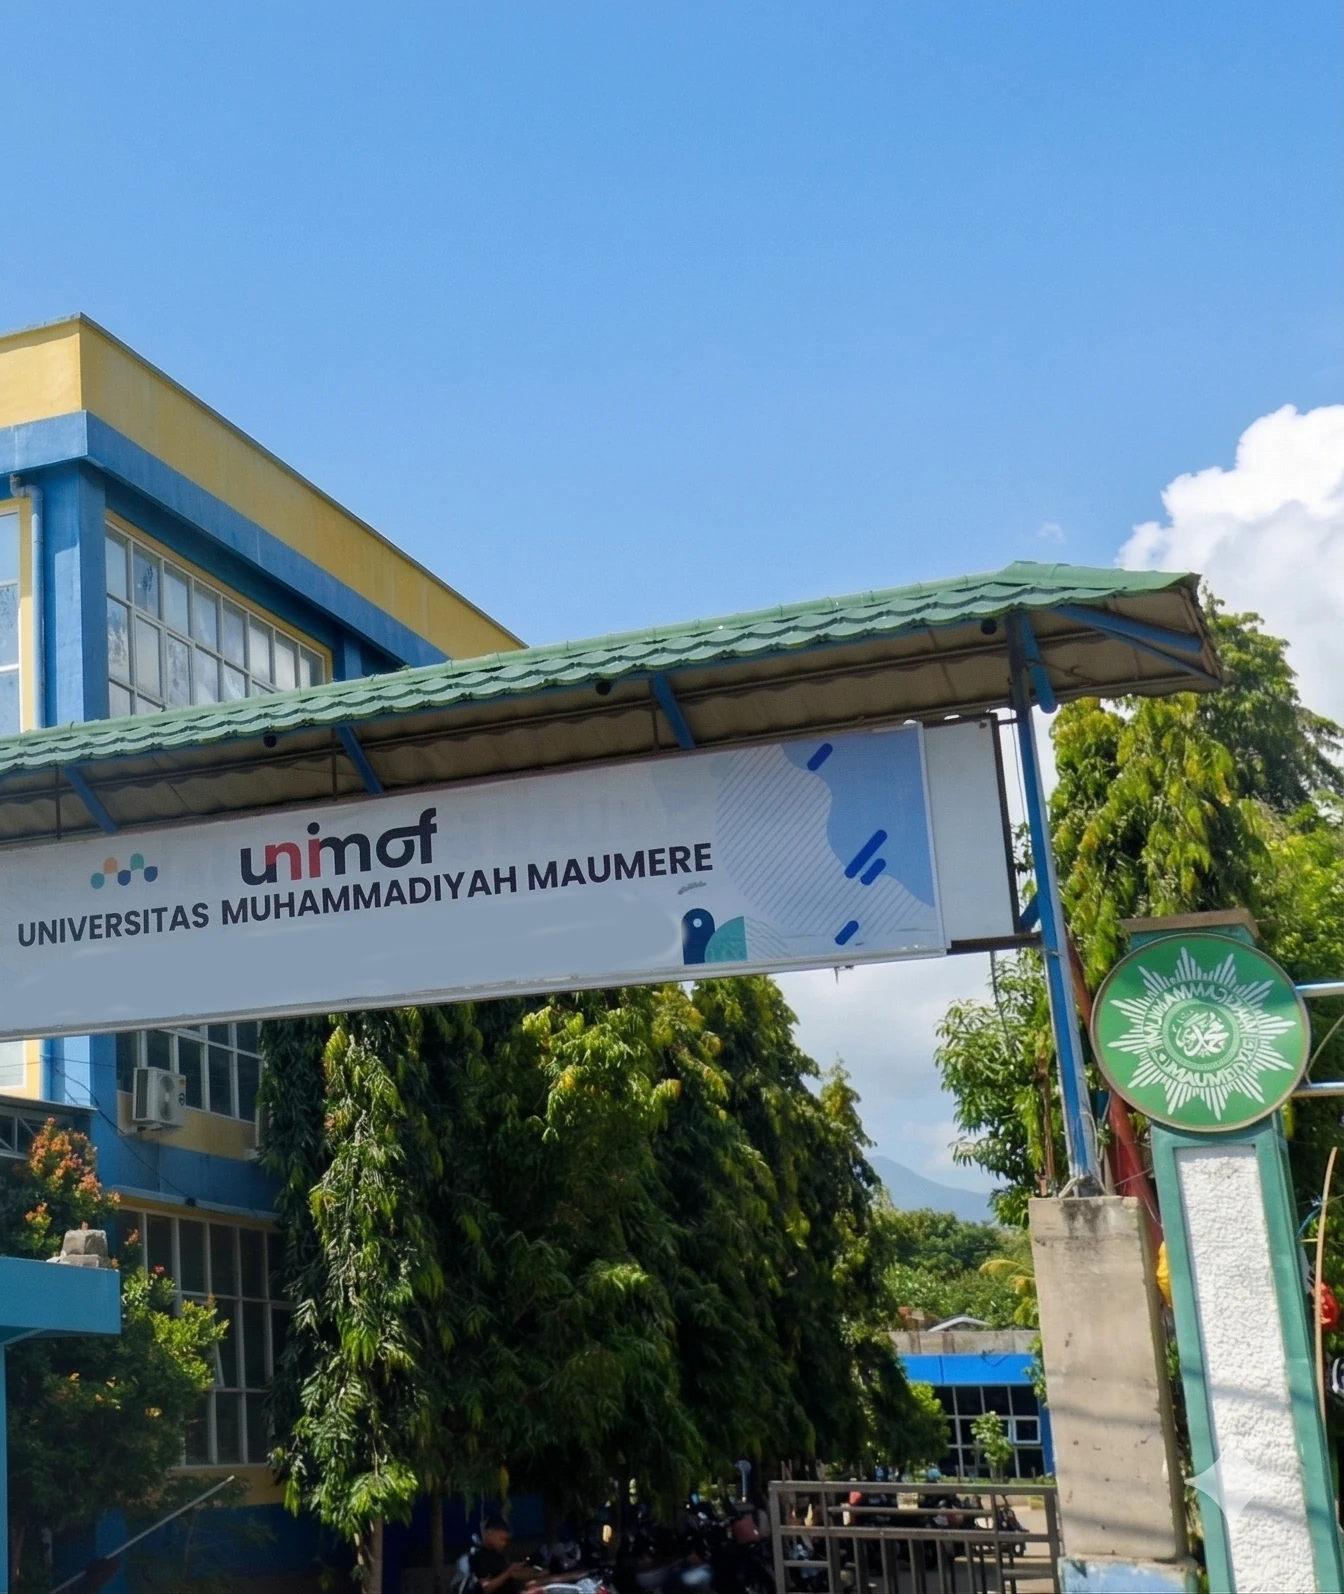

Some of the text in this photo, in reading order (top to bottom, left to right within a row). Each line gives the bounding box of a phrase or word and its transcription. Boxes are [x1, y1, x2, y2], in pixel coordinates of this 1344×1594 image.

[240, 807, 438, 886] unimof
[18, 903, 210, 947] UNIVERSITAS
[221, 861, 517, 926] MUHAMMADIYAH
[527, 842, 713, 891] MAUMERE
